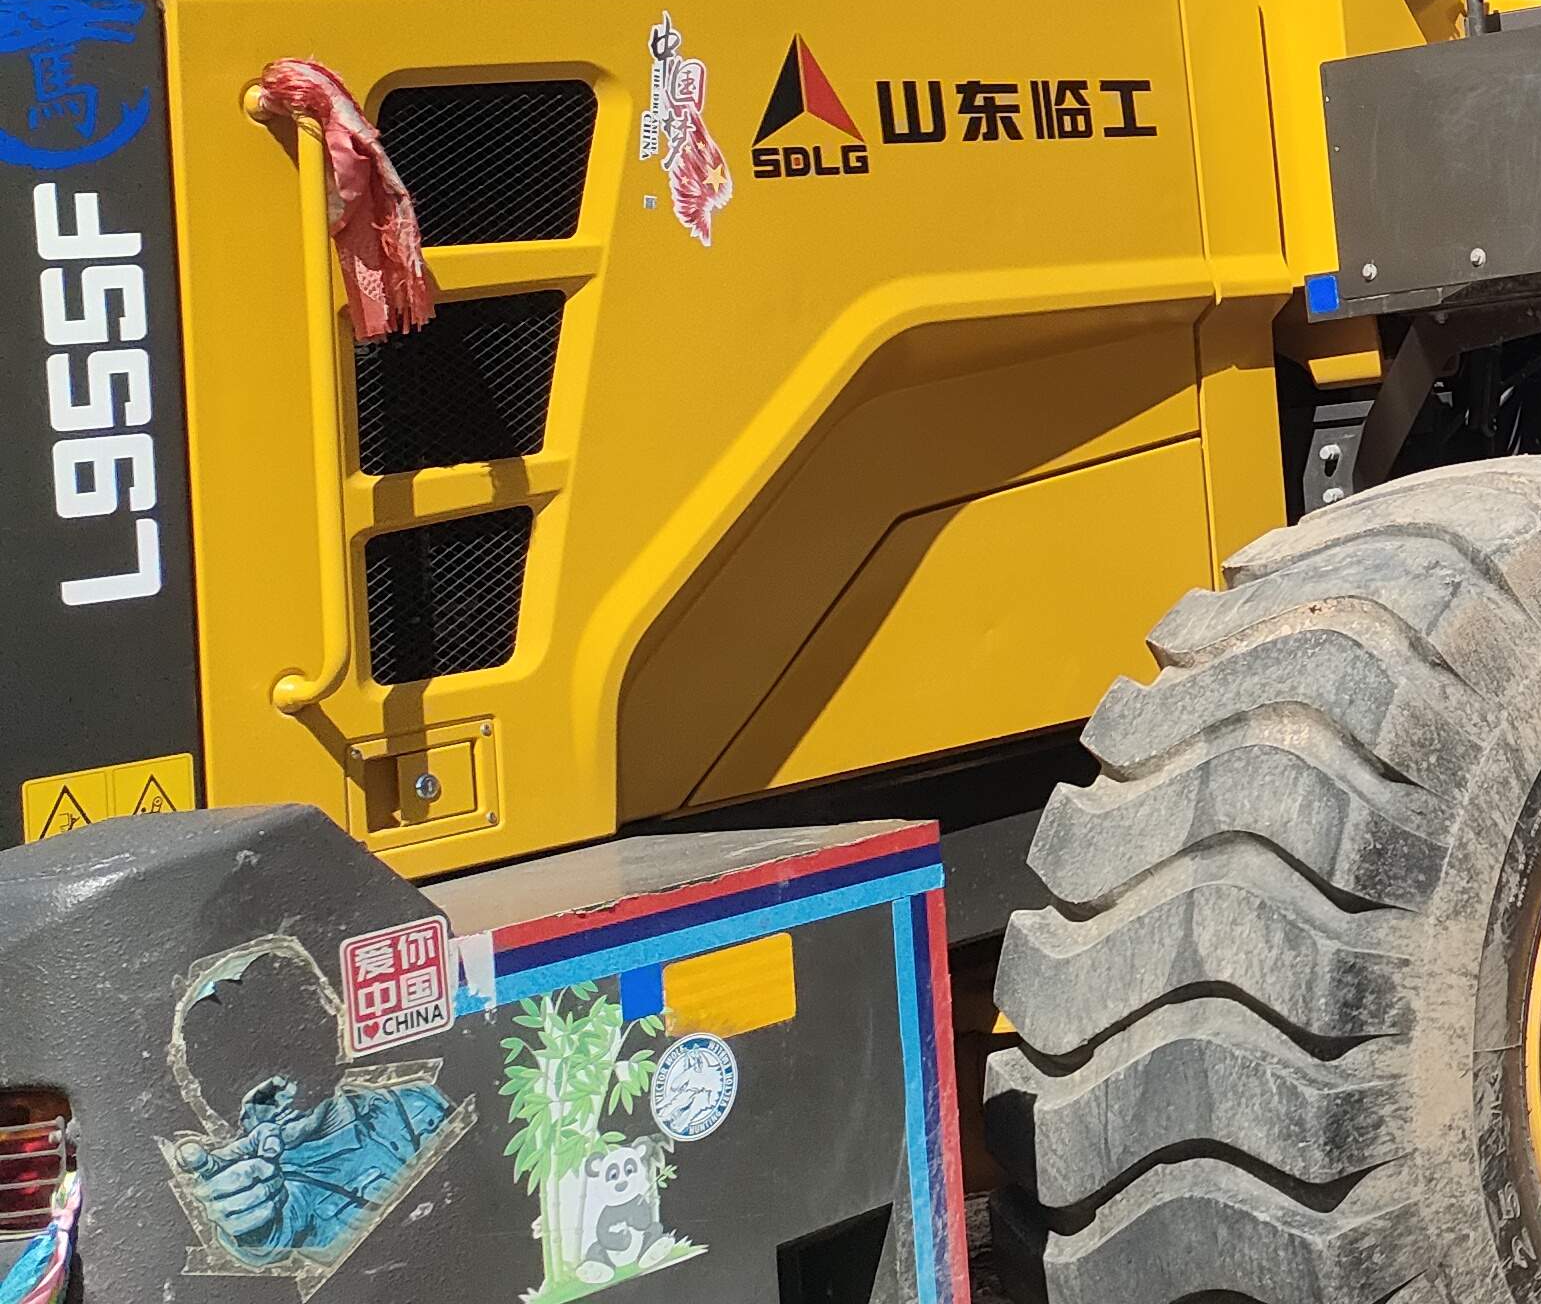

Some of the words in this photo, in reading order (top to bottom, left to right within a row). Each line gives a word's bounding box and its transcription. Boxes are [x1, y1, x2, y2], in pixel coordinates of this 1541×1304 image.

[876, 79, 1158, 145] 山东临工
[753, 144, 869, 179] SDLG
[33, 182, 162, 606] L955F
[355, 929, 436, 982] 爱你
[357, 965, 440, 1017] 中国
[357, 1026, 362, 1045] I
[382, 1003, 444, 1036] CHINA
